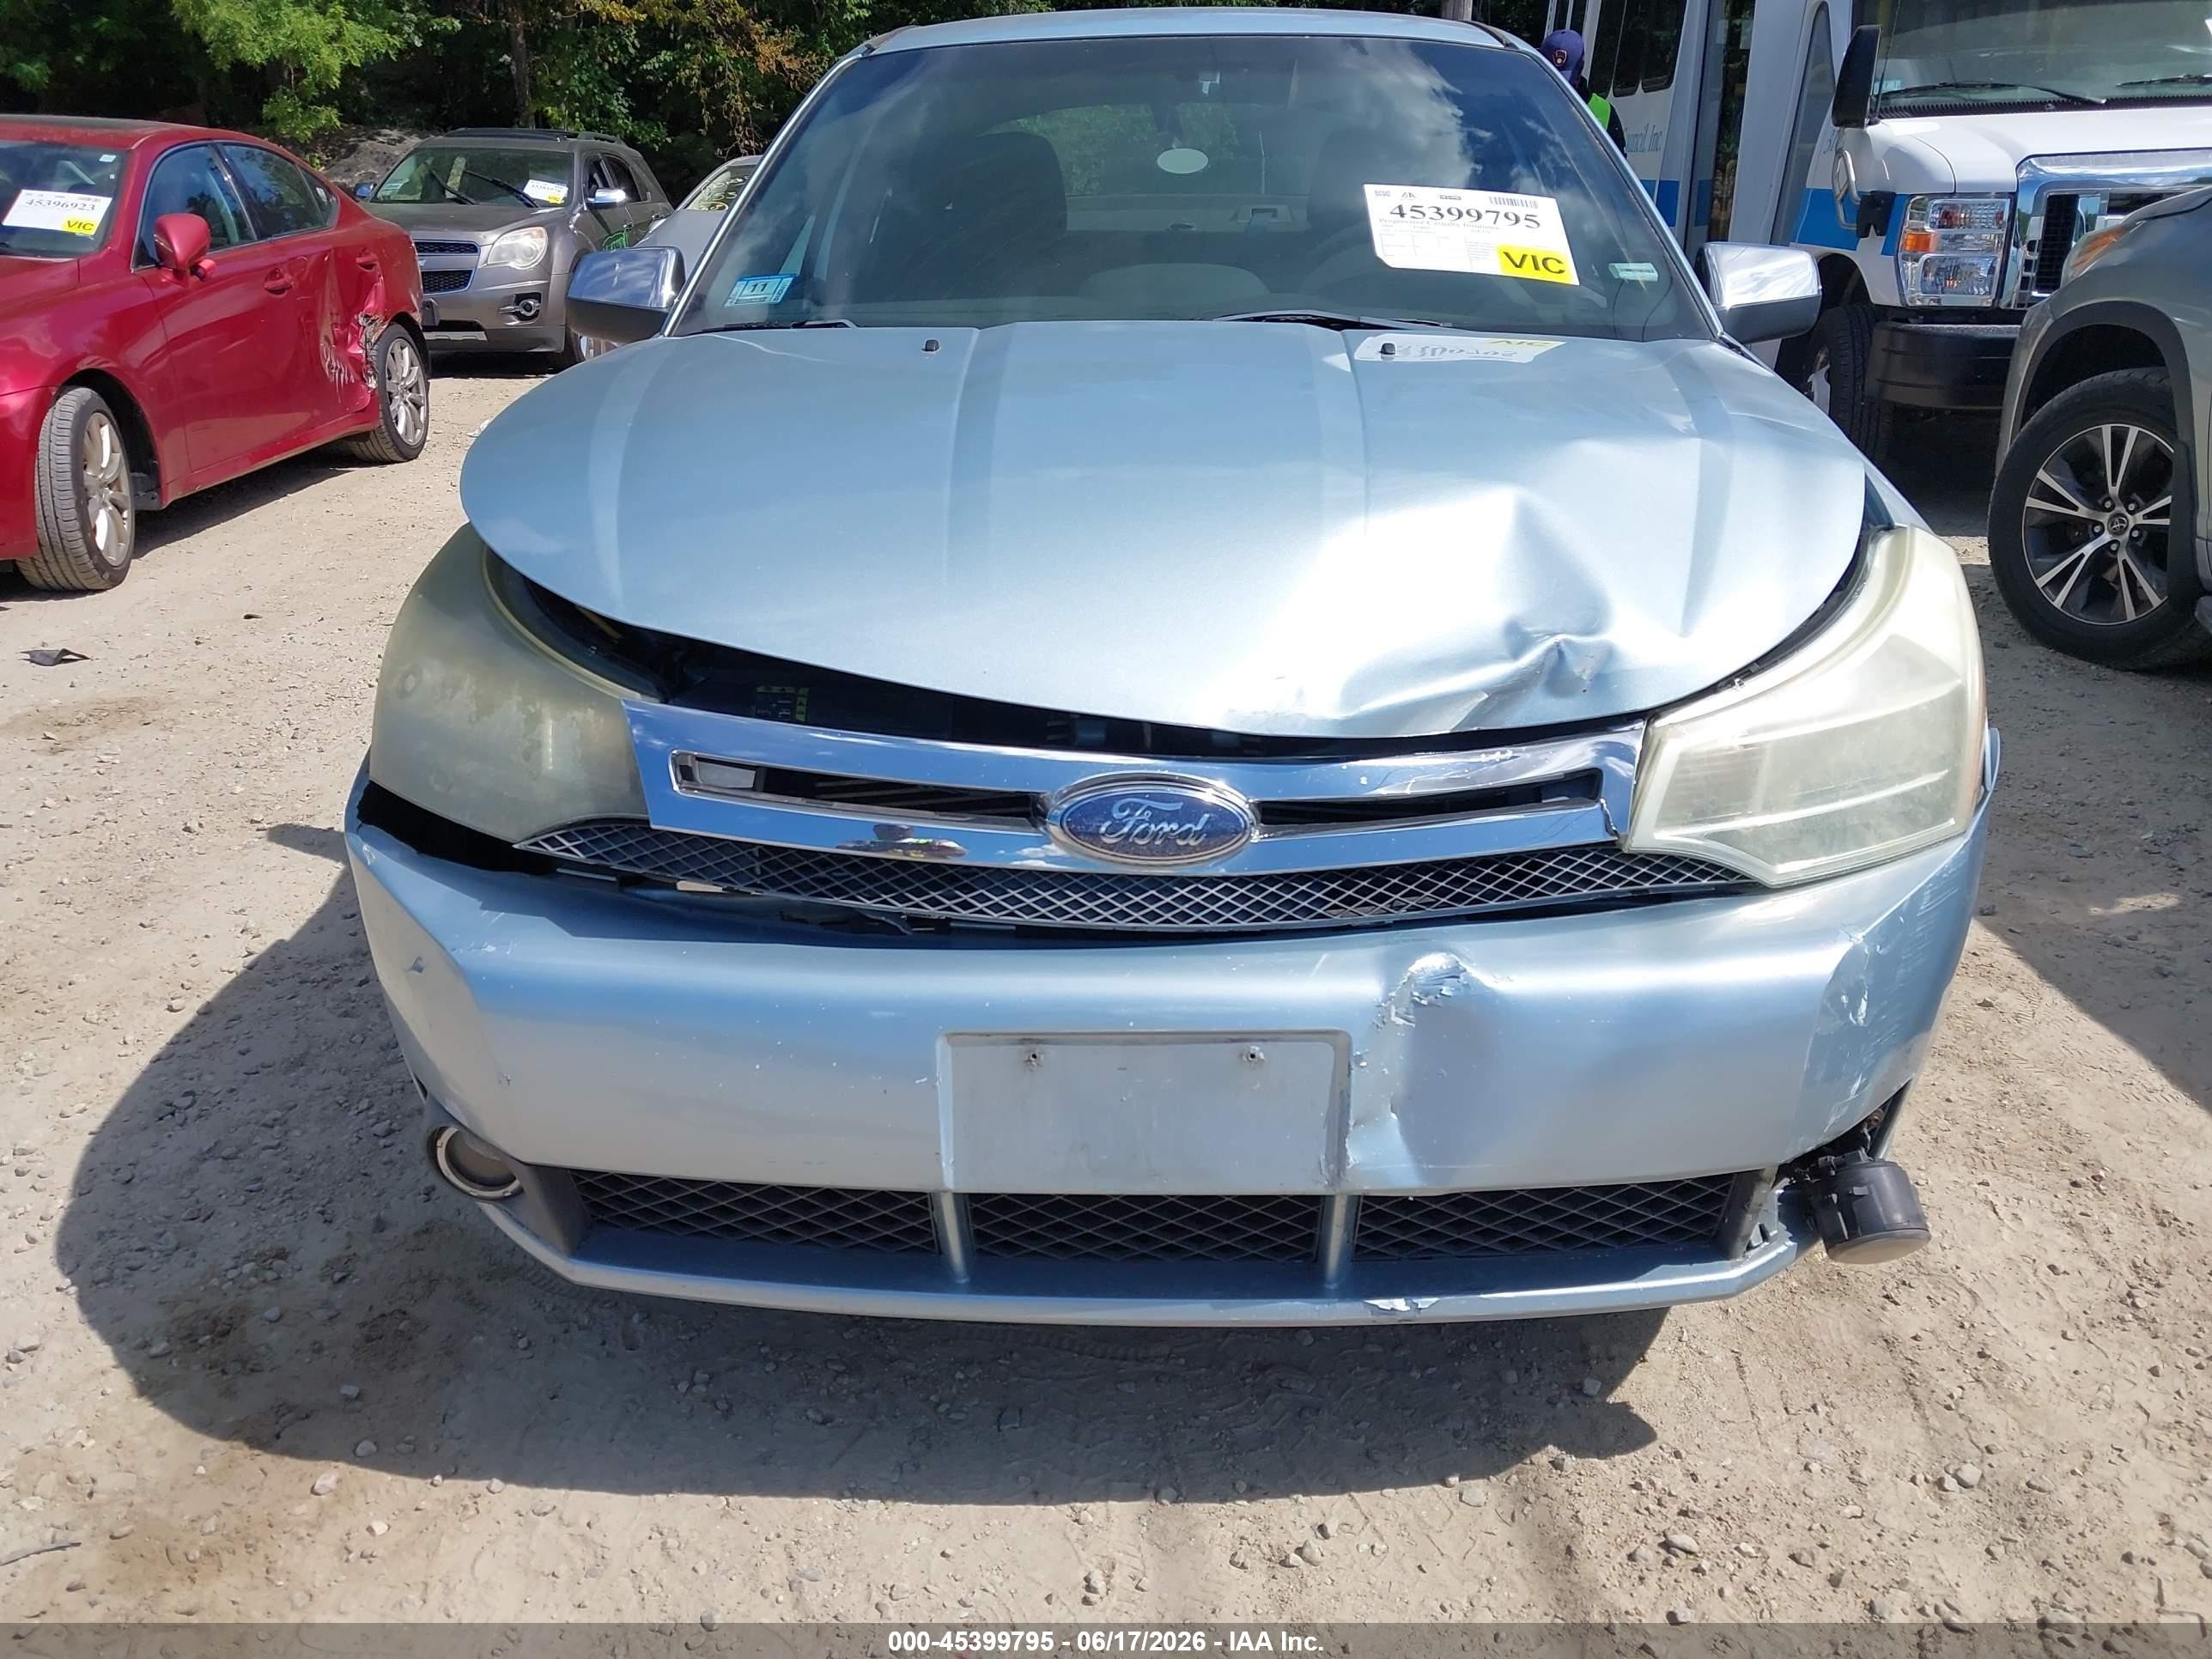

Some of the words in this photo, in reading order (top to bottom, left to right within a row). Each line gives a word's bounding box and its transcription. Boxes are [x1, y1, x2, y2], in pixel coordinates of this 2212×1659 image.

[26, 198, 96, 212] 45396923
[67, 220, 94, 231] VIC
[1389, 204, 1541, 229] 45399795
[1503, 252, 1566, 275] VIC
[750, 283, 769, 294] 11
[1100, 798, 1210, 847] Ford
